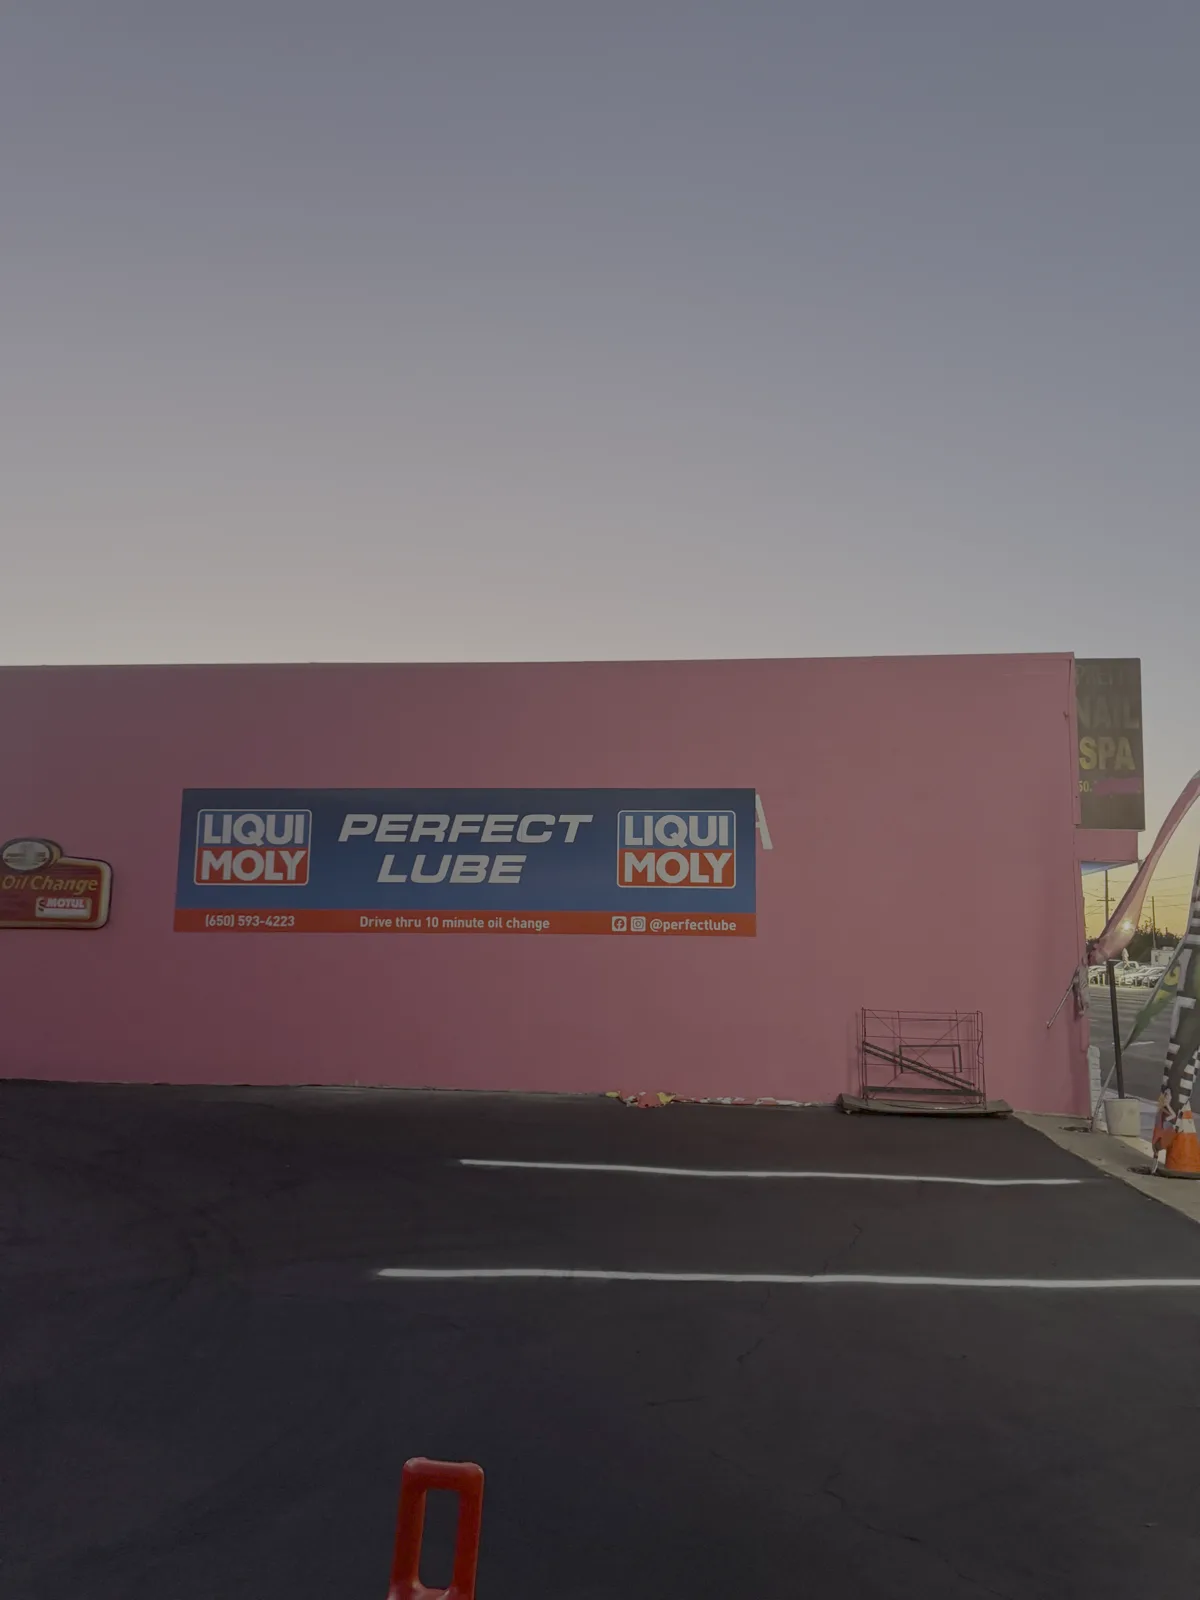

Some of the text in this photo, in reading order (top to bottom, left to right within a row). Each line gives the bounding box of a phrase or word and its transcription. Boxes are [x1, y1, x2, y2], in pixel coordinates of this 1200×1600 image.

[1079, 735, 1136, 771] SPA
[203, 813, 305, 847] LIQUI
[338, 813, 594, 843] PERFECT
[624, 814, 729, 848] LIQUI
[200, 849, 307, 882] MOLY
[377, 854, 527, 884] LUBE
[624, 851, 733, 884] MOLY
[2, 874, 99, 895] Oil Change
[46, 897, 85, 909] MOTUL
[205, 915, 295, 928] (650) 593-4223
[359, 915, 550, 931] Drive thru 10 minute oil change
[650, 918, 737, 932] @perfectlube
